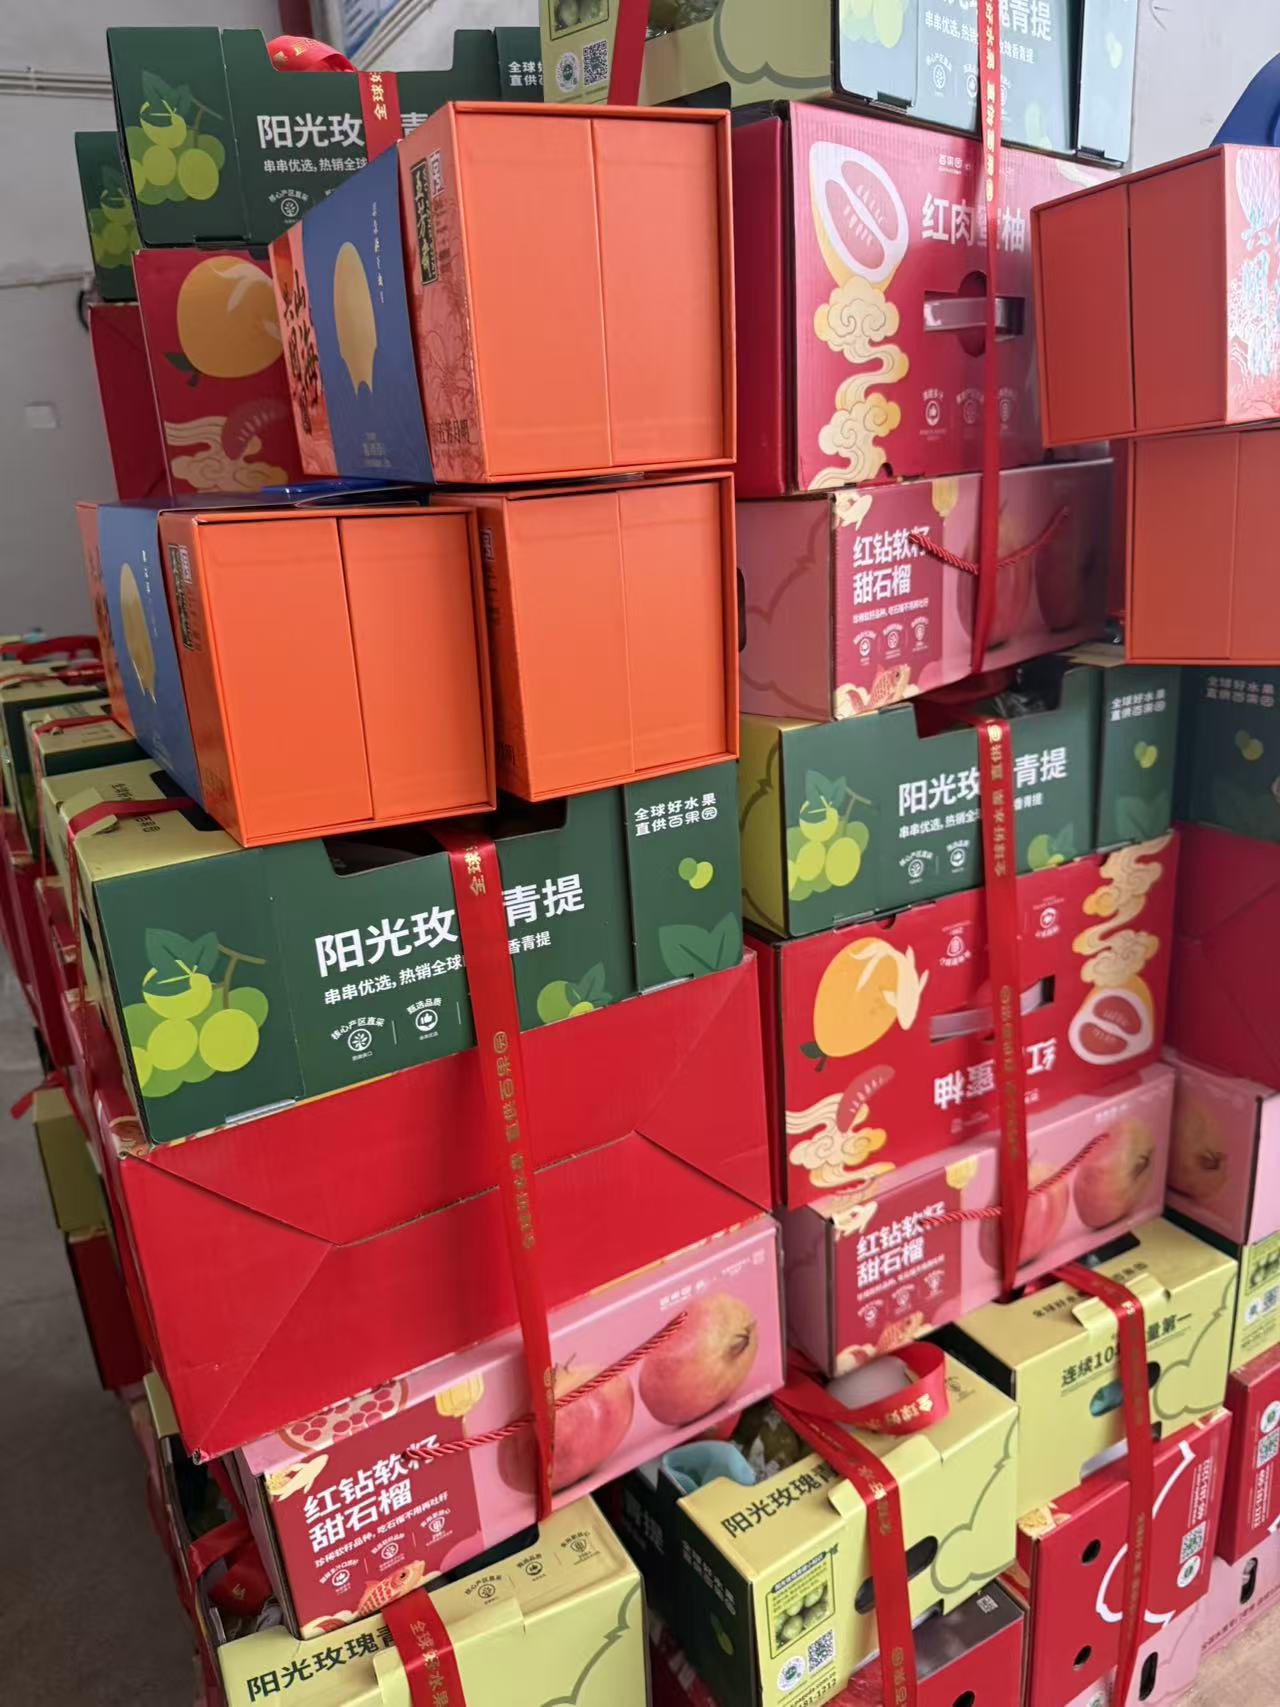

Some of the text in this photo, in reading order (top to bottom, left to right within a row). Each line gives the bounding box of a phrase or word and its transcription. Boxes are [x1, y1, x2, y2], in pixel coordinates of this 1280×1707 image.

[257, 112, 366, 149] 阳光玫
[853, 563, 912, 606] 甜石榴
[634, 793, 717, 821] 全球好水果
[898, 747, 1067, 817] 阳光玫 青提
[635, 807, 718, 836] 直供百果园
[465, 845, 487, 896] 全球
[314, 873, 585, 978] 阳光玫 青提
[324, 930, 551, 1006] 串串优选，热销全球 香青提
[330, 1016, 386, 1042] 核心产区直采
[857, 1236, 924, 1288] 甜石榴
[308, 1478, 413, 1553] 甜石榴
